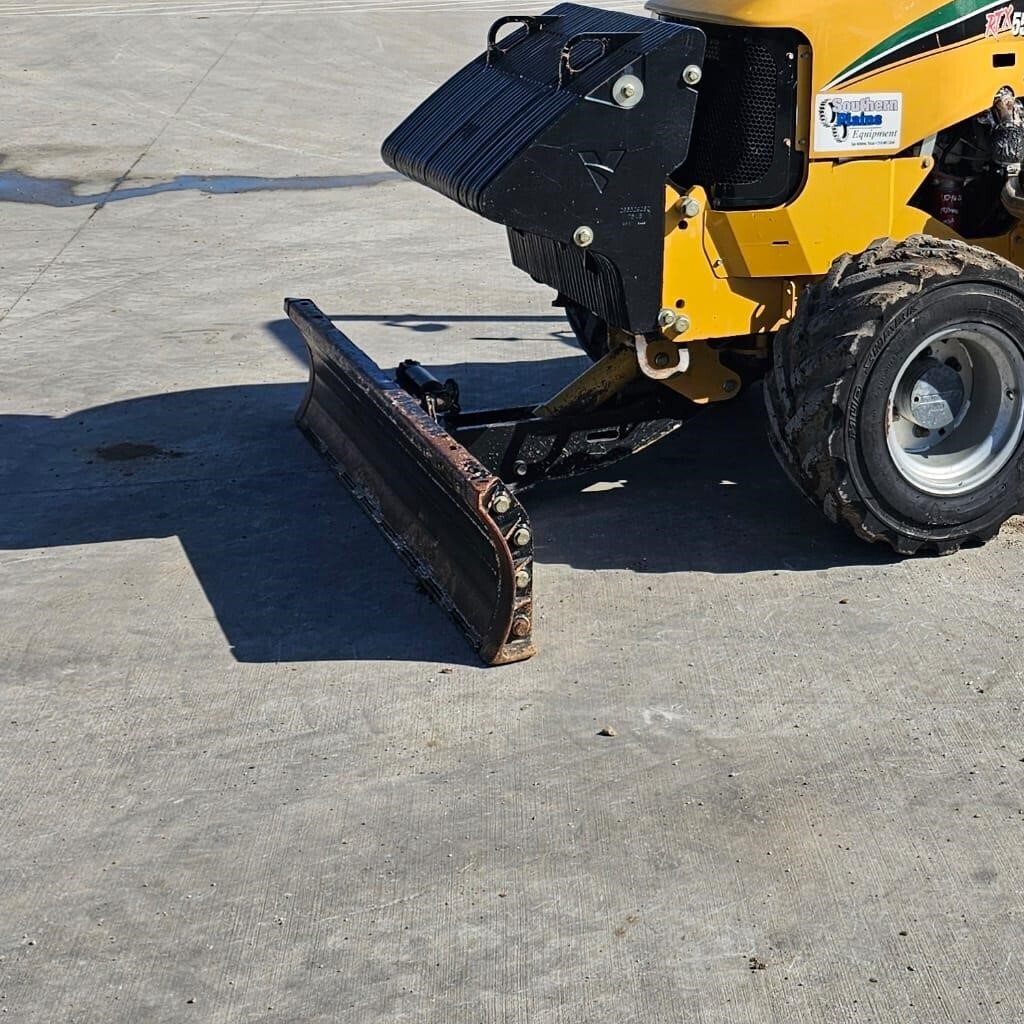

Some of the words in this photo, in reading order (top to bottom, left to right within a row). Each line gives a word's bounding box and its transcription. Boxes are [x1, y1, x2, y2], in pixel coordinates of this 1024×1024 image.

[832, 97, 899, 112] Southern
[836, 111, 883, 127] Plains
[852, 129, 898, 140] Equipment
